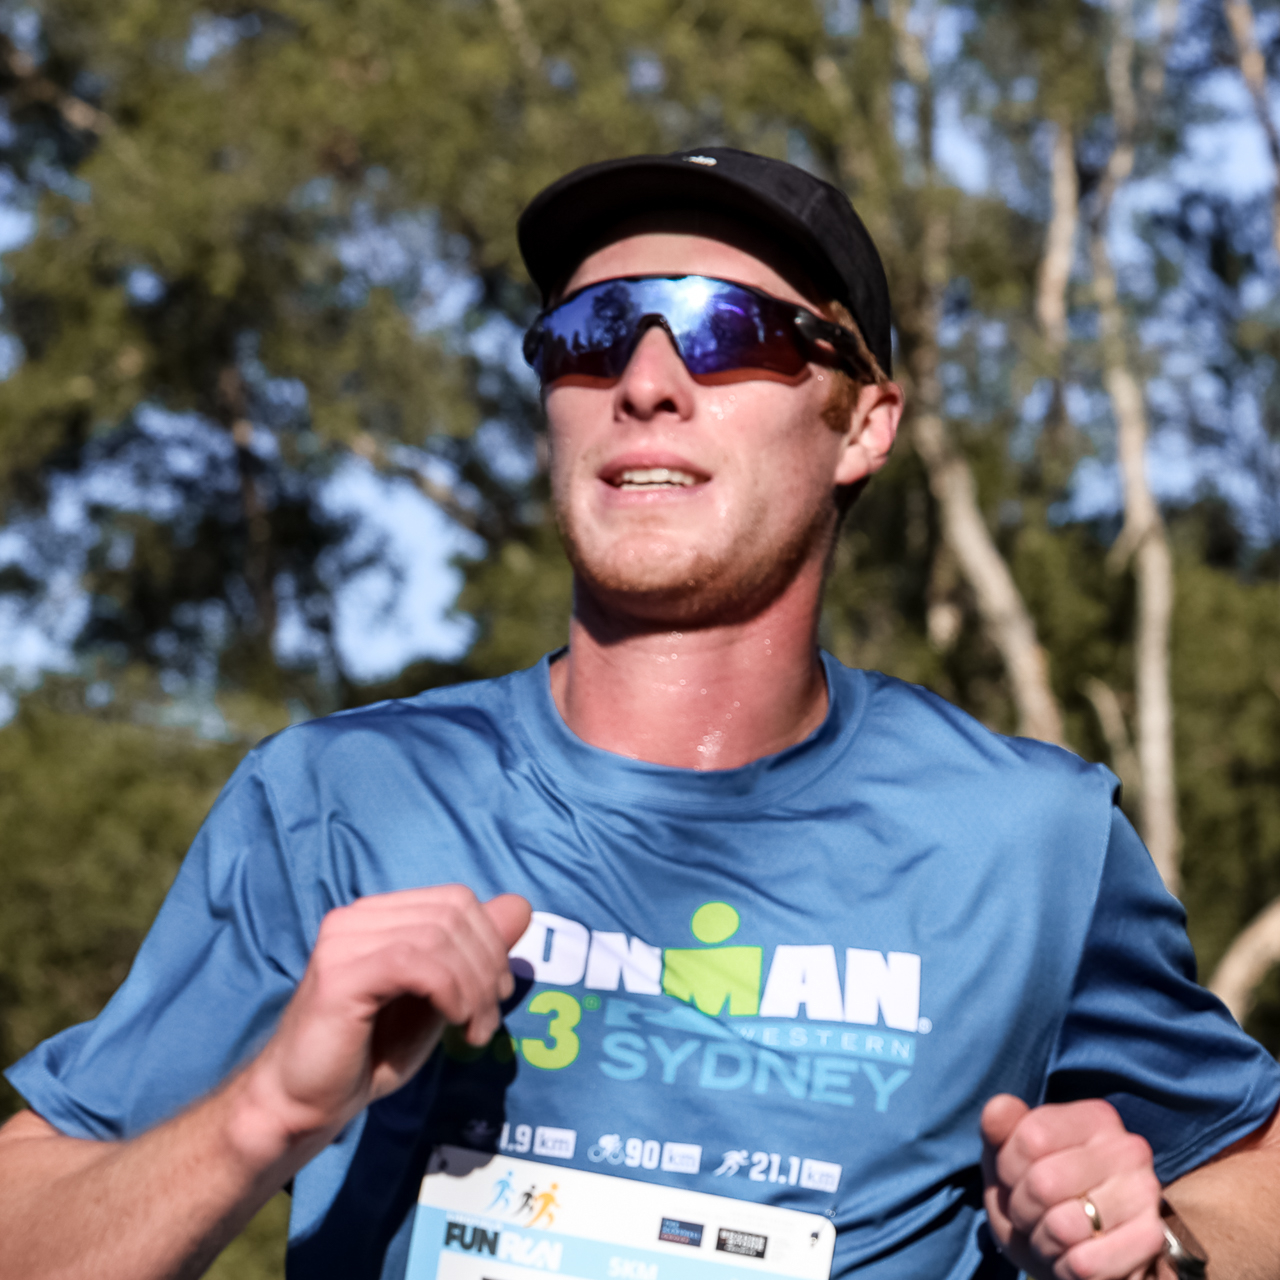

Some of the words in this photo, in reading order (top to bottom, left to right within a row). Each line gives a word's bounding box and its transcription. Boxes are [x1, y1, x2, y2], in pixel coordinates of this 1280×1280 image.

[508, 902, 920, 1032] ONMAN
[737, 1026, 912, 1060] WESTERN
[599, 1031, 911, 1113] SYDNEY
[499, 1121, 533, 1154] 1.9
[624, 1137, 661, 1170] 90
[748, 1151, 801, 1186] 21.1
